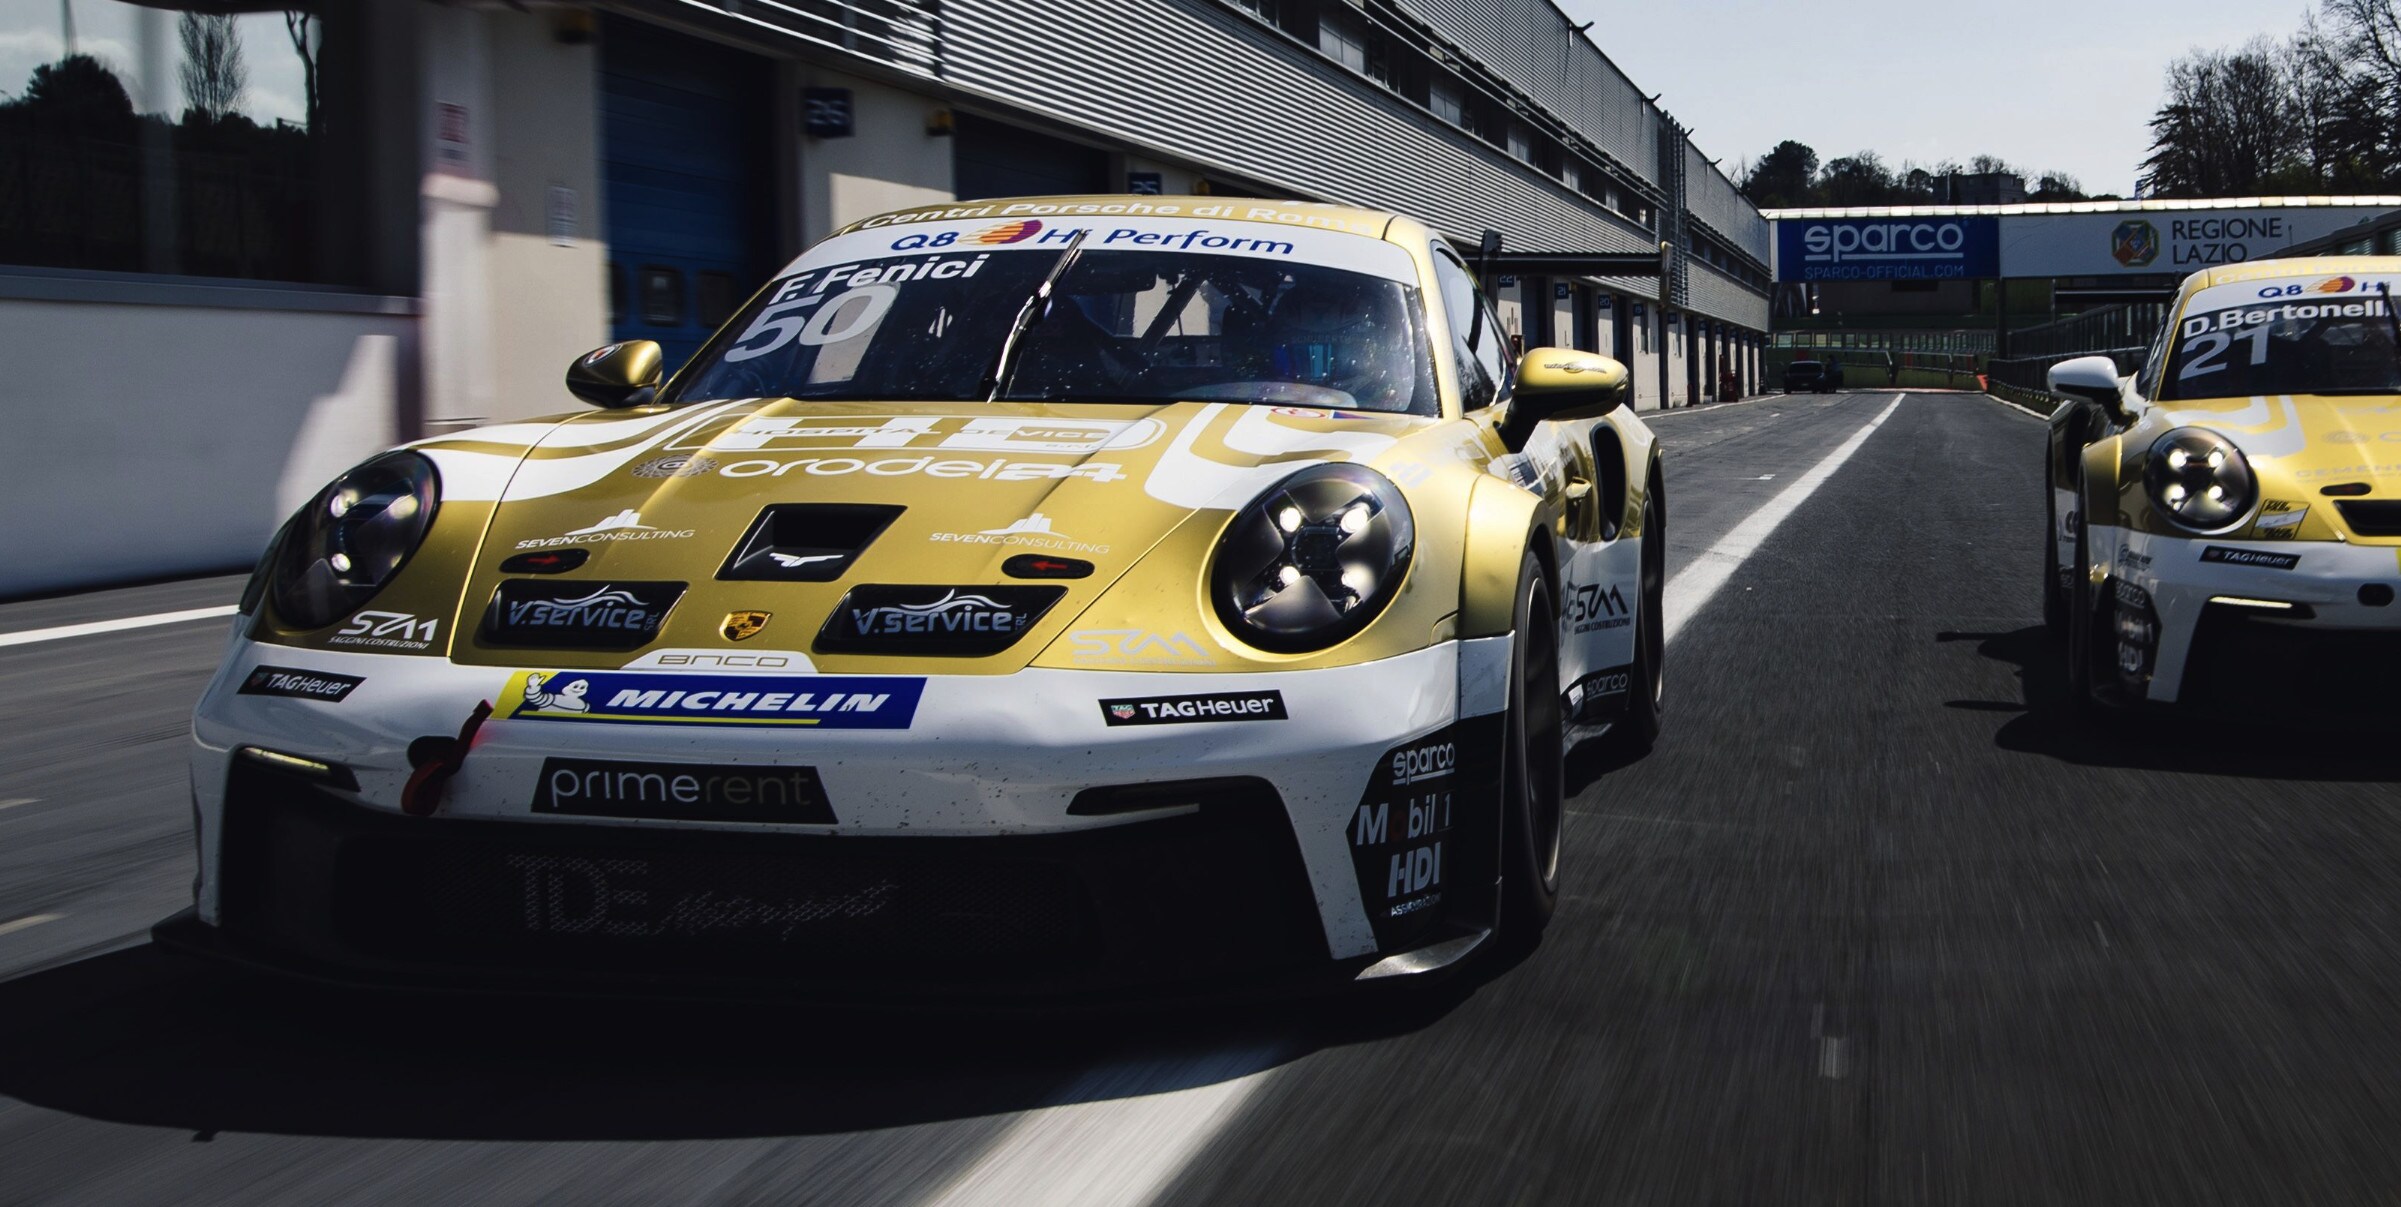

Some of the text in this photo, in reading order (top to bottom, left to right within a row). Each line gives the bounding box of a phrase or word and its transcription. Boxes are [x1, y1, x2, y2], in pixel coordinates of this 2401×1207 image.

[861, 204, 997, 229] Centri
[1000, 202, 1179, 216] Porsche
[1192, 204, 1232, 218] di
[2172, 217, 2282, 240] REGIONE
[891, 231, 960, 251] Q8
[1103, 229, 1294, 254] Perform
[1804, 223, 1964, 262] sparco
[2172, 243, 2248, 264] LAZIO
[1804, 265, 1964, 279] SPARCO-OFFICIAL.COM
[2258, 284, 2303, 298] Q8
[724, 284, 900, 363] 50
[2183, 299, 2391, 339] D.Bertonell
[2178, 324, 2270, 382] 21
[605, 688, 891, 713] MICHELIN
[1392, 742, 1456, 786] sparco
[551, 768, 813, 808] primerent
[1386, 840, 1442, 898] HDI
[506, 852, 649, 938] TDE
